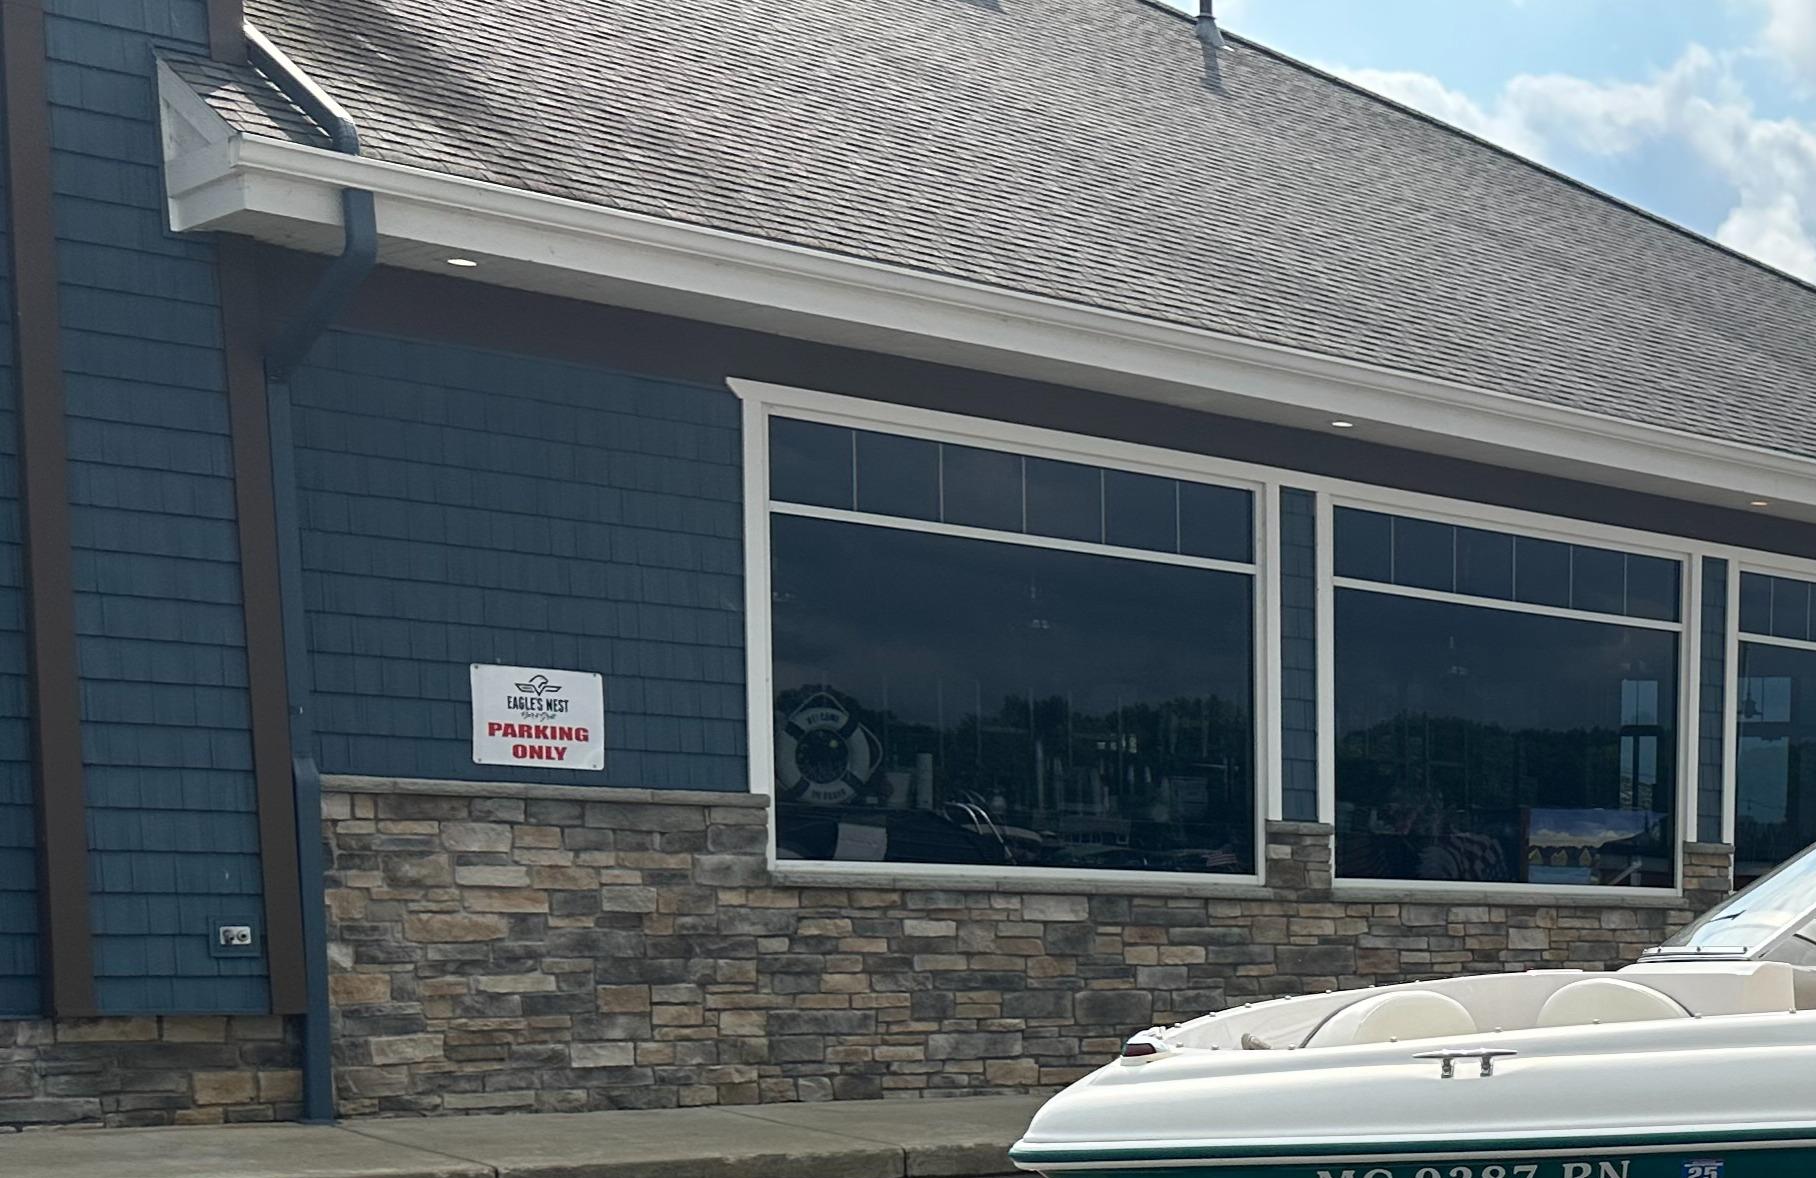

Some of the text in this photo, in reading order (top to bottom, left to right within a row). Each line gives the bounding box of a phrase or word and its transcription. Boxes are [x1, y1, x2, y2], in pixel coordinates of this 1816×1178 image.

[507, 695, 569, 713] EAGLE'S NEST
[488, 722, 589, 742] PARKING
[512, 744, 567, 761] ONLY
